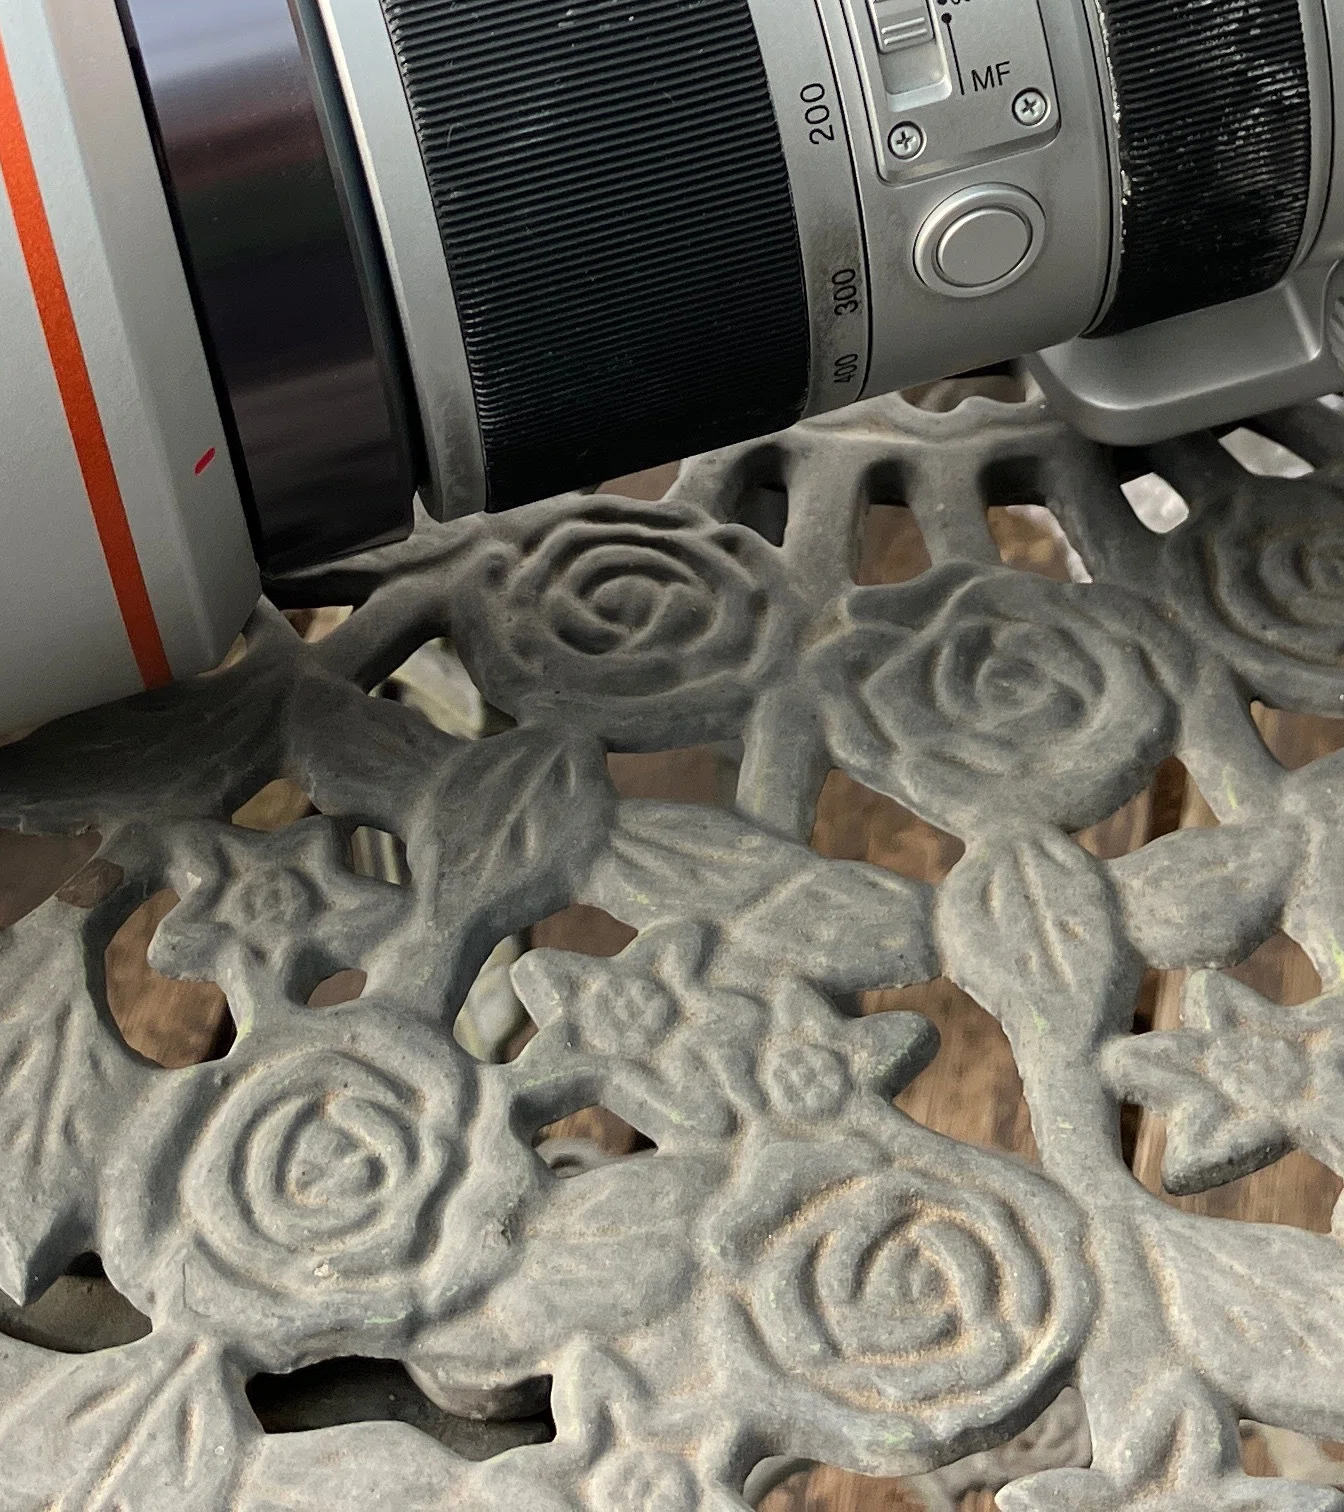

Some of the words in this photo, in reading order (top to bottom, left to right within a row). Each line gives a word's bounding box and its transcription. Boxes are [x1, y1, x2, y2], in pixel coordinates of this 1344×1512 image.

[971, 61, 1011, 93] MF
[800, 82, 834, 145] 200
[833, 268, 857, 317] 300
[833, 353, 858, 384] 400
